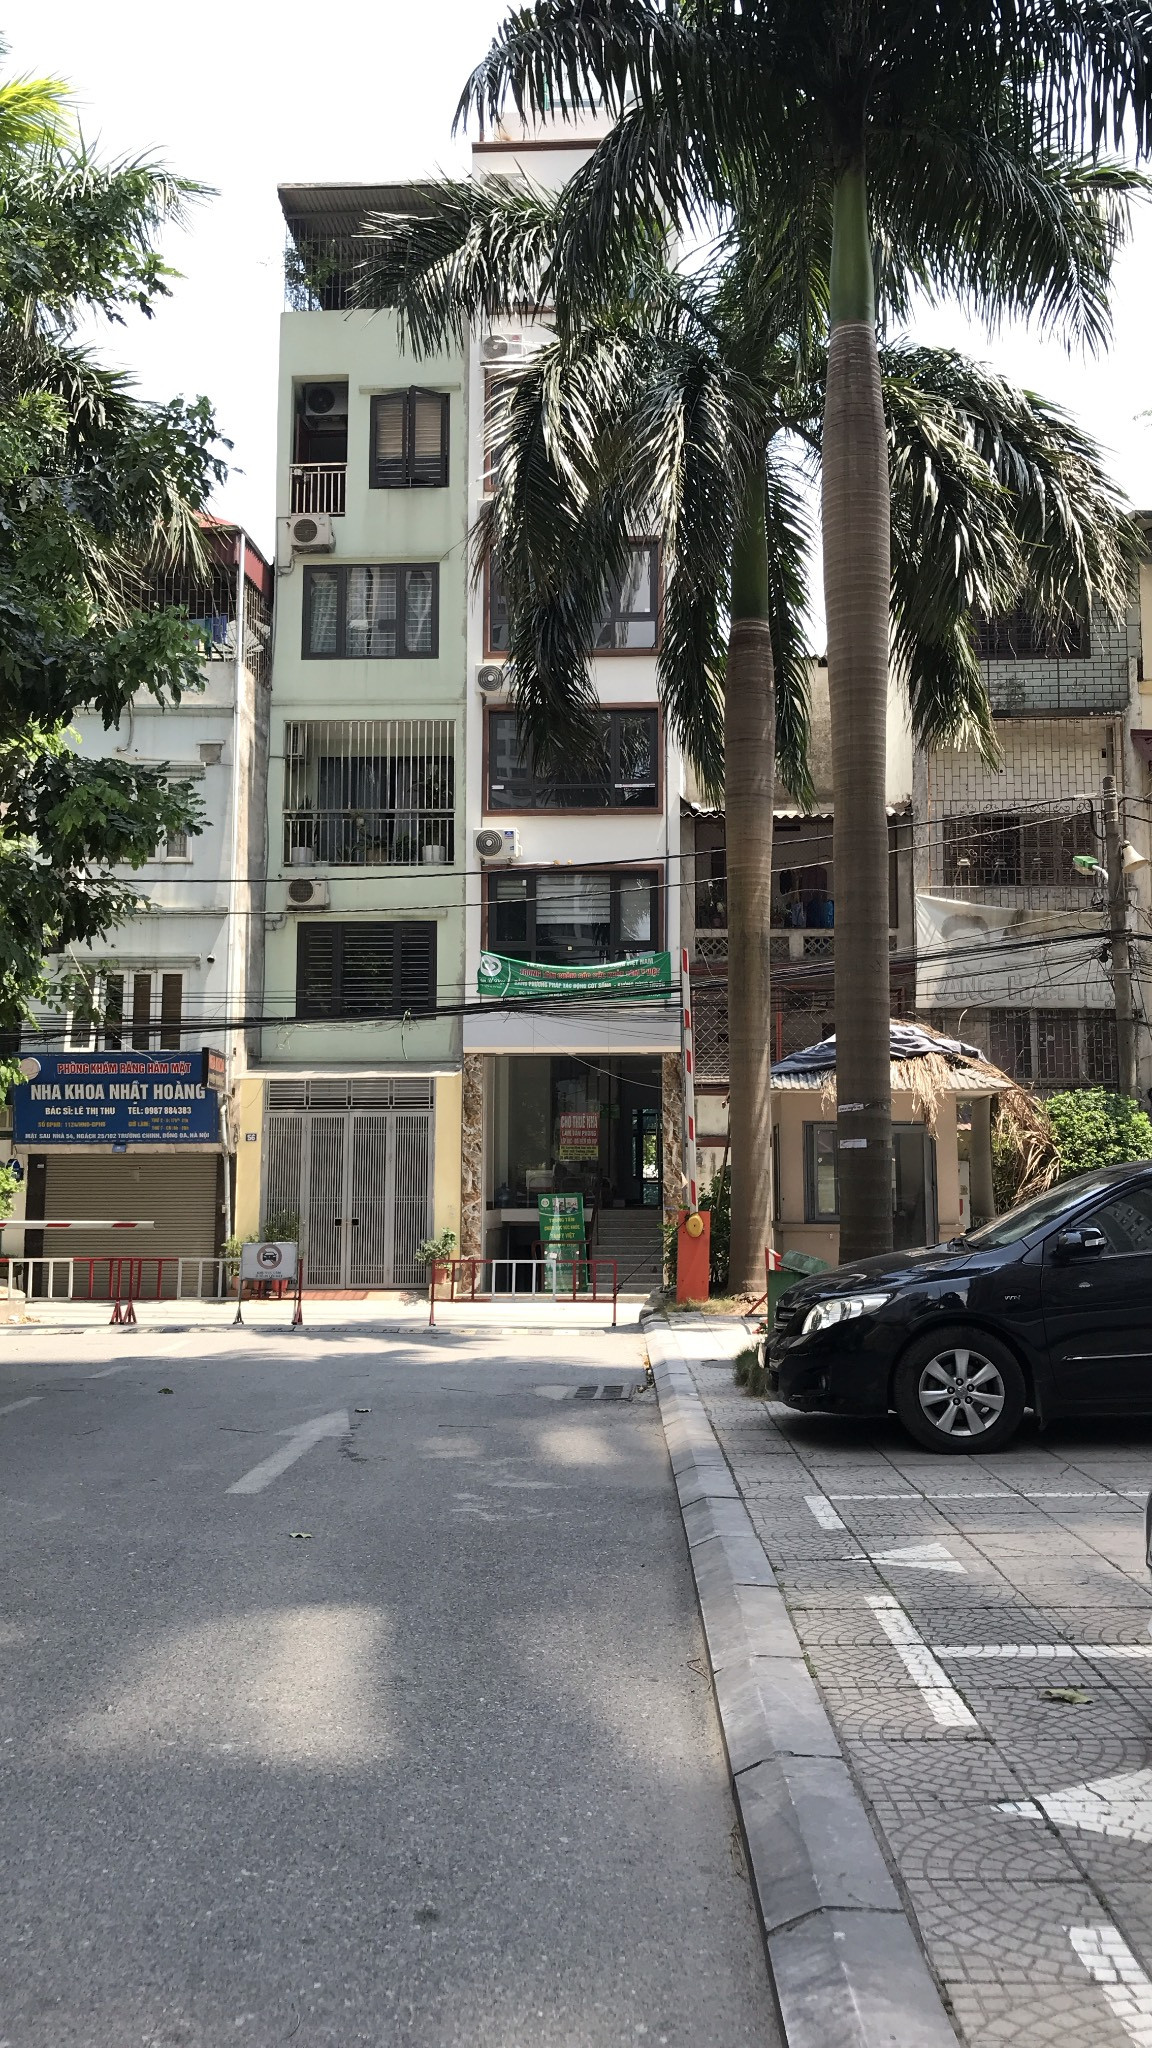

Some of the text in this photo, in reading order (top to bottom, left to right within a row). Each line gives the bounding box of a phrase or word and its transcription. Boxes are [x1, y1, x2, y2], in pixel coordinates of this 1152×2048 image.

[57, 1060, 89, 1074] PHÒNG
[90, 1061, 118, 1074] KHÁM
[120, 1060, 146, 1074] RĂNG
[171, 1061, 192, 1076] MẶT
[31, 1084, 61, 1100] NHA
[65, 1083, 104, 1100] KHOA
[110, 1080, 148, 1104] NHẬT
[154, 1080, 206, 1100] HOÀNG
[45, 1106, 63, 1115] BÁC
[74, 1106, 84, 1115] LÊ
[85, 1107, 99, 1116] THỊ
[100, 1107, 115, 1115] THU
[128, 1106, 144, 1115] TEL:
[145, 1106, 162, 1115] 0987
[561, 1115, 571, 1128] CHO
[572, 1113, 585, 1128] THUÊ
